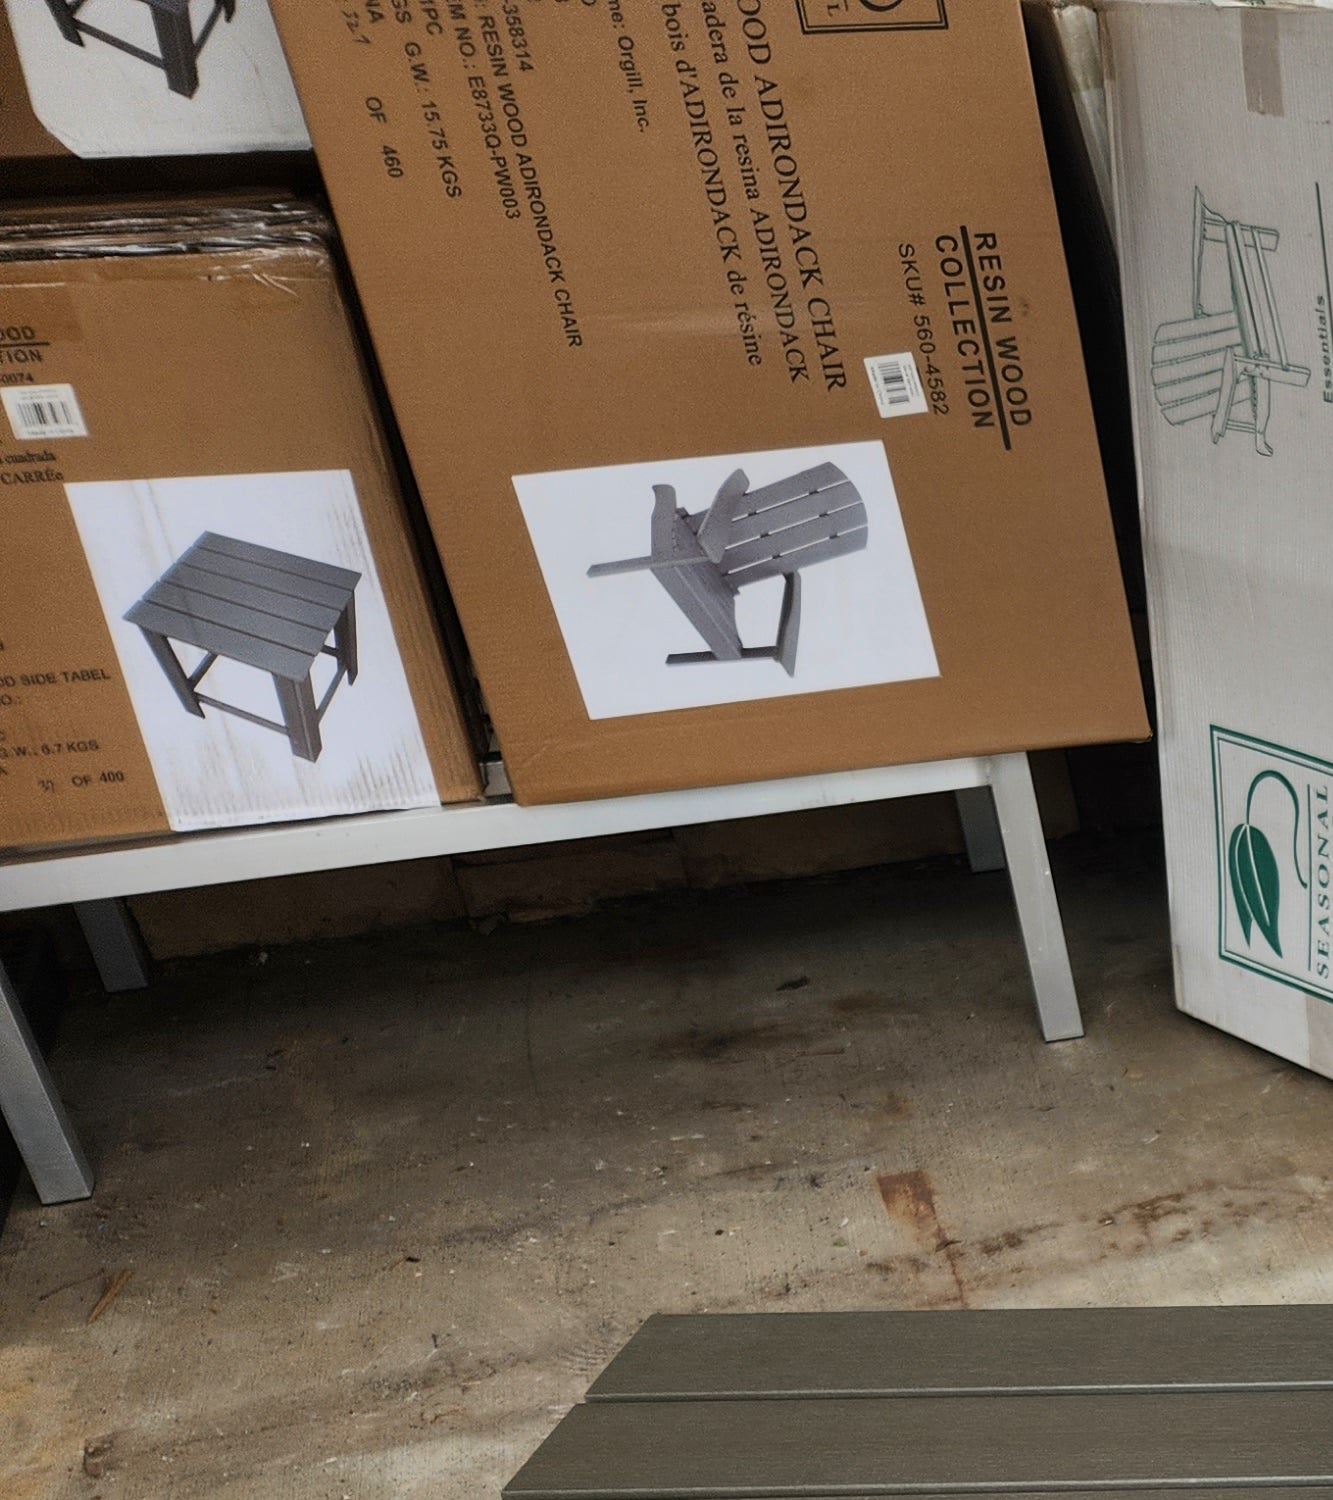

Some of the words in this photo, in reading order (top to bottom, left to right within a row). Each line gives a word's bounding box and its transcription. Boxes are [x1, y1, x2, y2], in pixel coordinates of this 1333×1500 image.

[662, 3, 689, 52] bois
[617, 36, 645, 94] Orgill,
[632, 99, 650, 134] Inc.
[718, 72, 740, 99] de
[726, 106, 745, 126] la
[366, 97, 388, 124] OF
[382, 145, 404, 179] 460
[421, 100, 449, 150] 15.75
[437, 155, 463, 199] KGS
[478, 15, 510, 77] RESIN
[497, 83, 529, 148] WOOD
[515, 152, 567, 284] ADIRONDACK
[554, 288, 584, 348] CHAIR
[675, 59, 742, 264] d'ADIRONDACK
[732, 133, 760, 200] resina
[754, 75, 824, 290] ADIRONDACK
[807, 297, 848, 392] CHAIR
[726, 270, 747, 296] de
[750, 208, 810, 384] ADIRONDACK
[898, 243, 926, 306] SKU#
[914, 315, 950, 416] 560-4582
[935, 234, 996, 428] COLLECTION
[974, 232, 1013, 324] RESIN
[996, 336, 1033, 427] WOOD
[735, 302, 762, 366] résine
[1315, 295, 1333, 404] Essentials
[20, 673, 58, 687] SIDE
[61, 668, 111, 683] TABEL
[66, 738, 100, 754] KGS
[71, 774, 92, 788] OF
[100, 769, 125, 784] 400
[1316, 785, 1330, 979] SEASONAL
